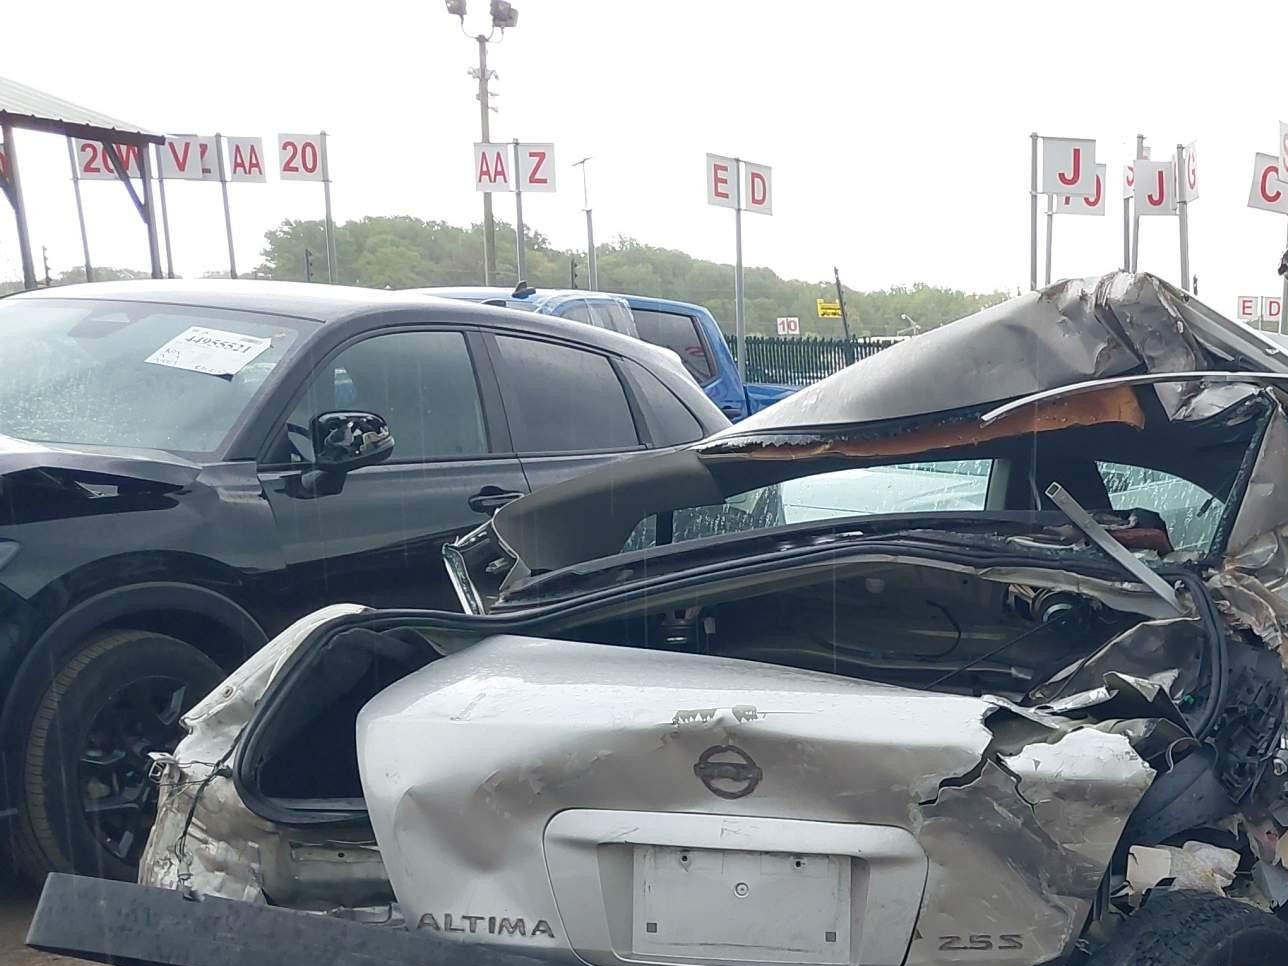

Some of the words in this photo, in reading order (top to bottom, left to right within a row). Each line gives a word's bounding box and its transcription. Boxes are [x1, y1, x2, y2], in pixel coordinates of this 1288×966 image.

[167, 141, 191, 172] V
[233, 144, 263, 175] AA
[282, 140, 318, 174] 20
[478, 152, 508, 184] AA
[528, 151, 548, 184] Z
[1058, 148, 1080, 186] J
[713, 163, 730, 199] E
[750, 171, 767, 205] D
[1147, 170, 1165, 207] J
[1260, 165, 1282, 203] C
[1242, 300, 1253, 315] E
[1269, 301, 1280, 316] D
[779, 320, 798, 332] 10
[416, 913, 555, 938] ALTIMA
